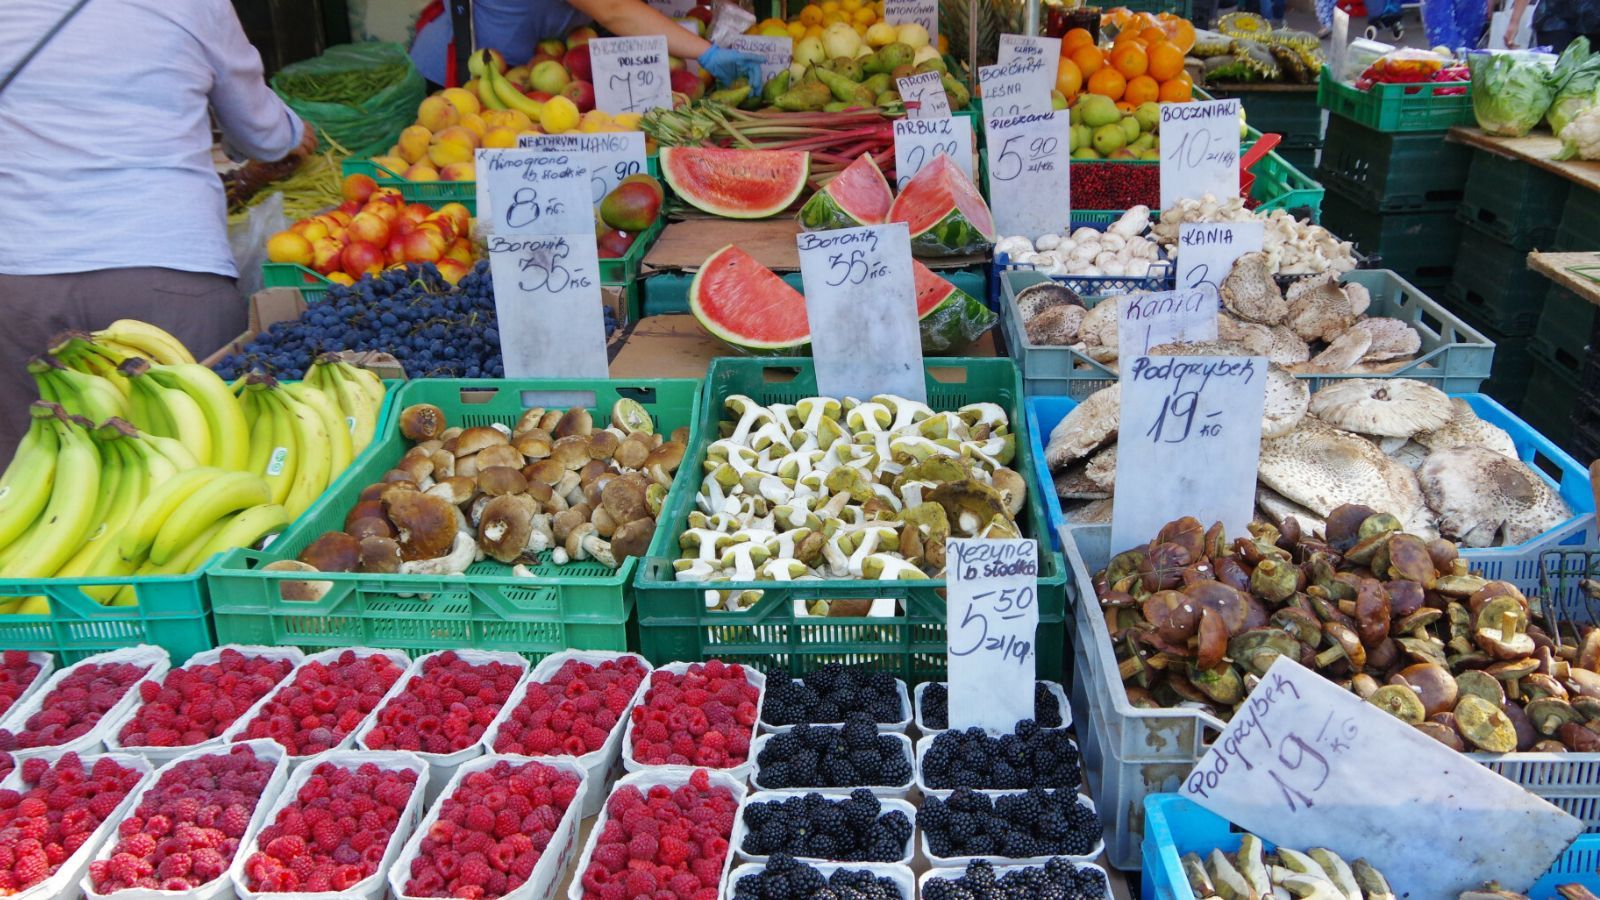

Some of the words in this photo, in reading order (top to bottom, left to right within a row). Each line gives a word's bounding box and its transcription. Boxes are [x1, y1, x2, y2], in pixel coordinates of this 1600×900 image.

[617, 54, 661, 67] POLSKIE
[637, 70, 654, 87] 90
[984, 82, 1022, 99] LEŚNA
[1160, 102, 1236, 122] BOCZNIAKI
[896, 119, 952, 135] ARBUZ
[580, 134, 630, 152] MANGO
[992, 134, 1025, 181] 5
[1029, 136, 1058, 158] 90
[506, 187, 541, 228] 8
[1181, 227, 1234, 246] KANIA
[1126, 292, 1205, 320] Kania
[1131, 356, 1254, 396] Podgrzybek
[949, 590, 997, 657] 5
[1187, 673, 1301, 800] Podgrzybek
